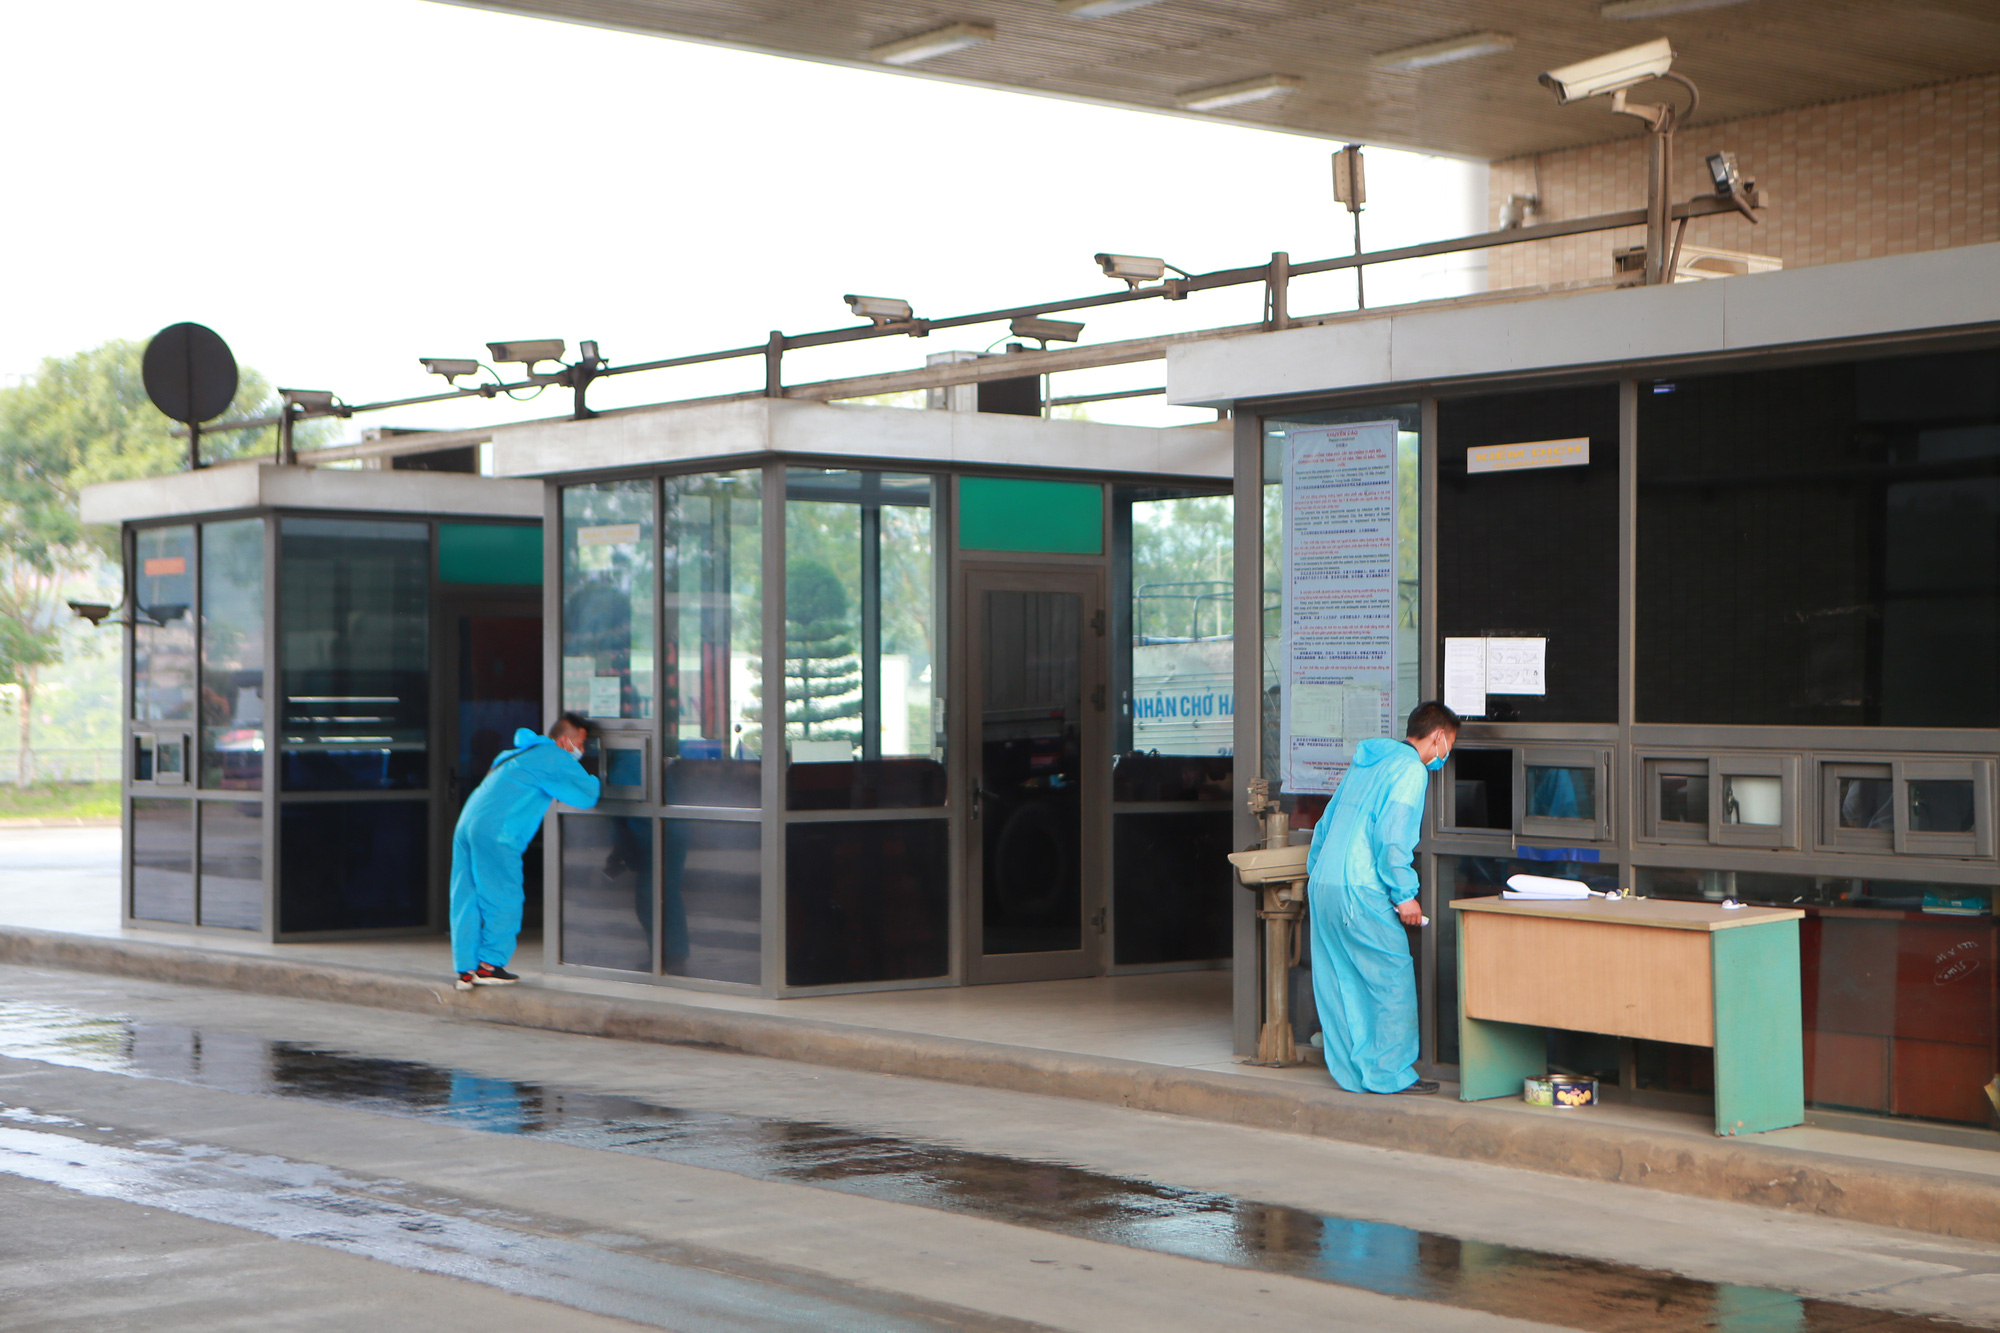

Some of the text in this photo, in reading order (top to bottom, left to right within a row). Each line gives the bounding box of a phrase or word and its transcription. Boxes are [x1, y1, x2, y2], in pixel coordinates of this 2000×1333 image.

[1476, 445, 1581, 462] KIỂM DỊCH
[1133, 691, 1177, 722] NHẬN
[1180, 685, 1213, 717] CHỞ
